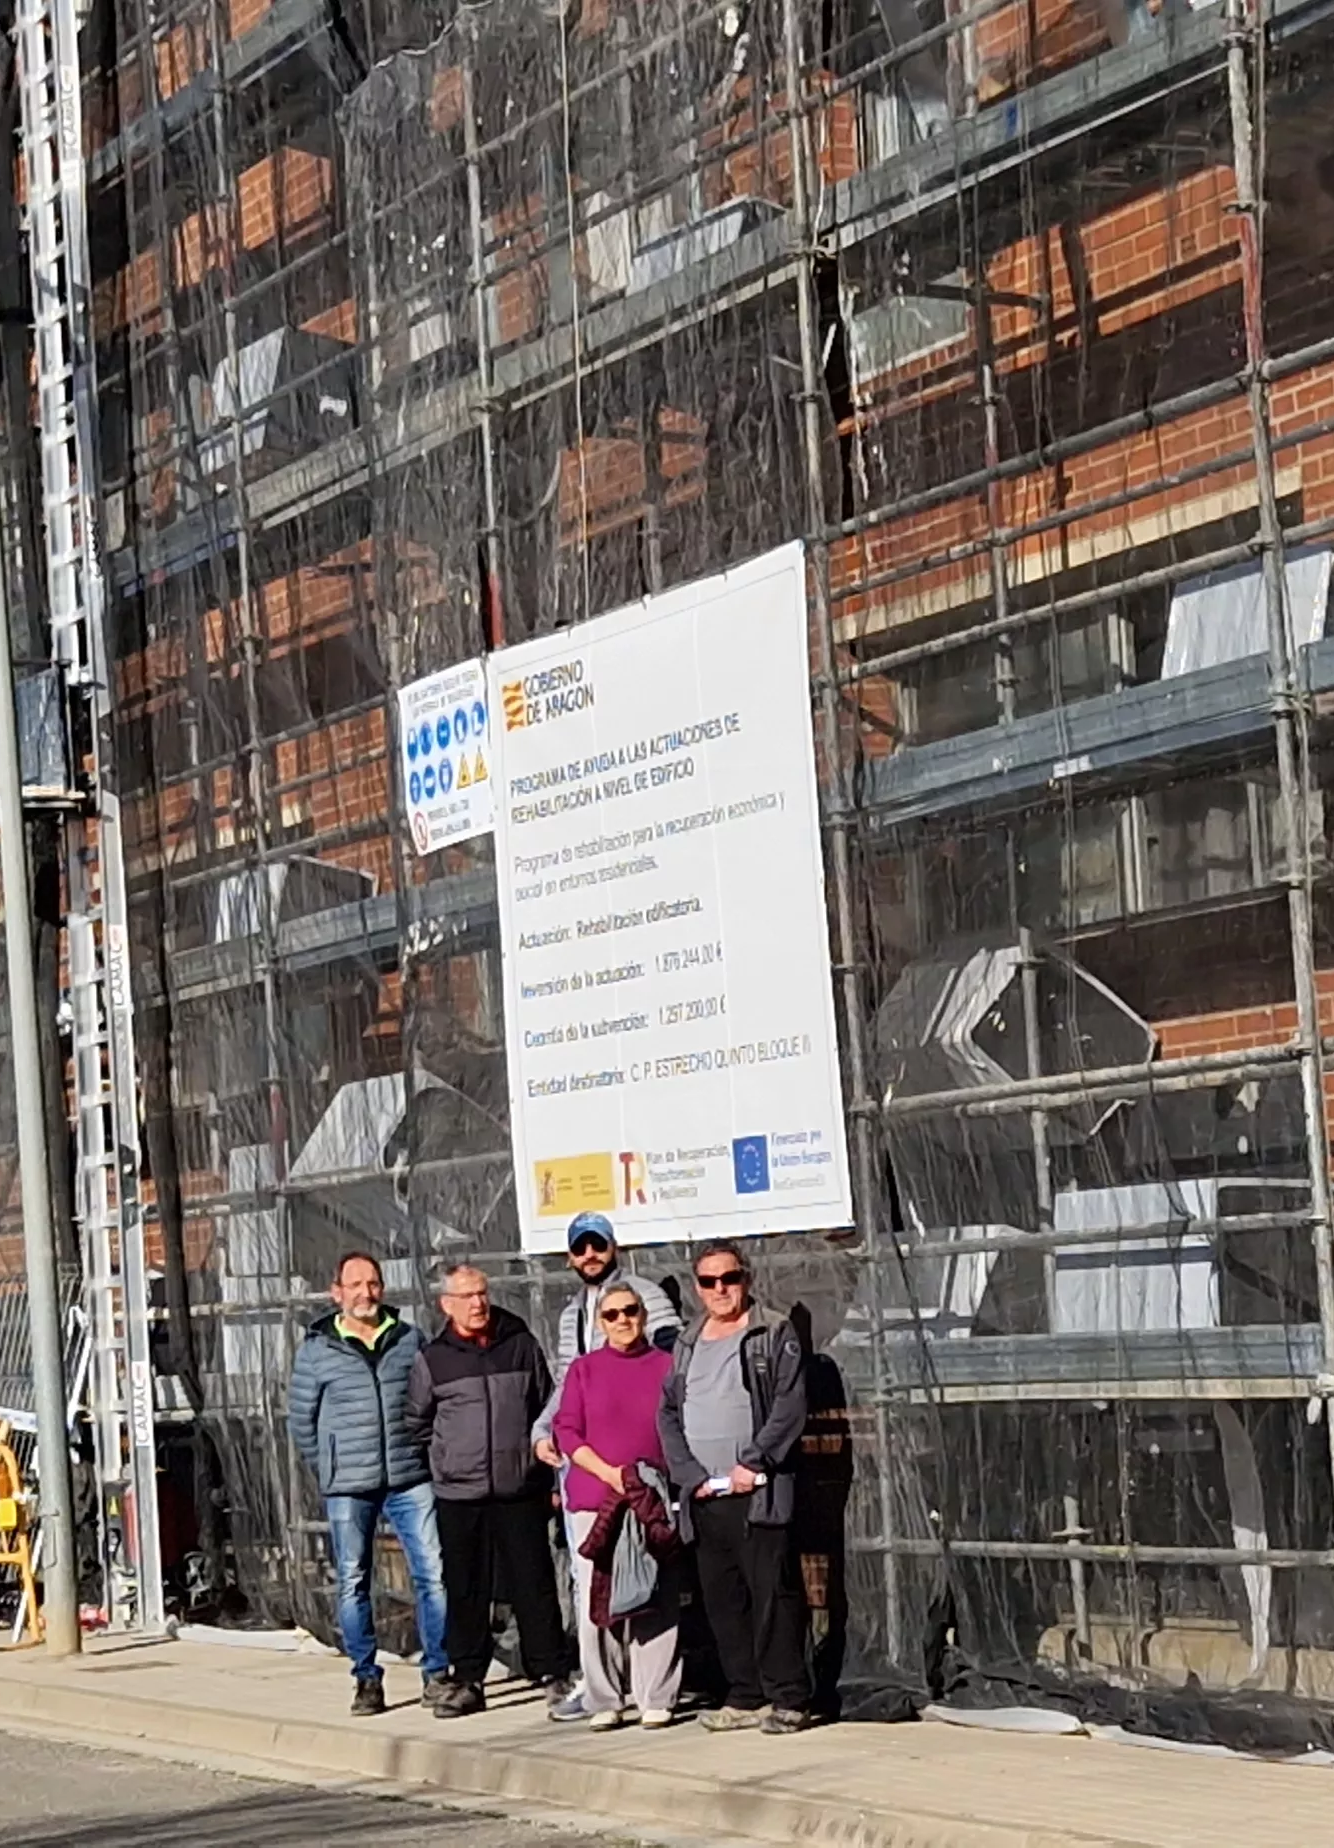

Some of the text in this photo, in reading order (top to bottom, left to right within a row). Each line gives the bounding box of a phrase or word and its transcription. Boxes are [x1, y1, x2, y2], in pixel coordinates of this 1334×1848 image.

[523, 659, 584, 698] GOBIERNO
[527, 700, 542, 726] DE
[510, 712, 741, 798] PROGRAMA DE AYUDA A LAS ACTUACIONES DE
[511, 757, 695, 824] REHABILITACIÓN A NIVEL DE EDIFICIO
[514, 852, 559, 875] Programa
[561, 845, 573, 863] de
[633, 826, 654, 848] para
[655, 821, 665, 838] la
[665, 804, 726, 836] recuperación
[576, 909, 644, 939] Rehabilitación
[521, 976, 569, 999] Inversión
[570, 972, 583, 991] de
[584, 969, 594, 987] la
[524, 1025, 564, 1048] Cuantía
[566, 1023, 578, 1042] de
[579, 1021, 589, 1039] la
[527, 1075, 567, 1098] Entidad
[655, 1050, 713, 1079] ESTRECHO
[714, 1043, 755, 1069] QUINTO
[757, 1036, 800, 1062] BLOQUE
